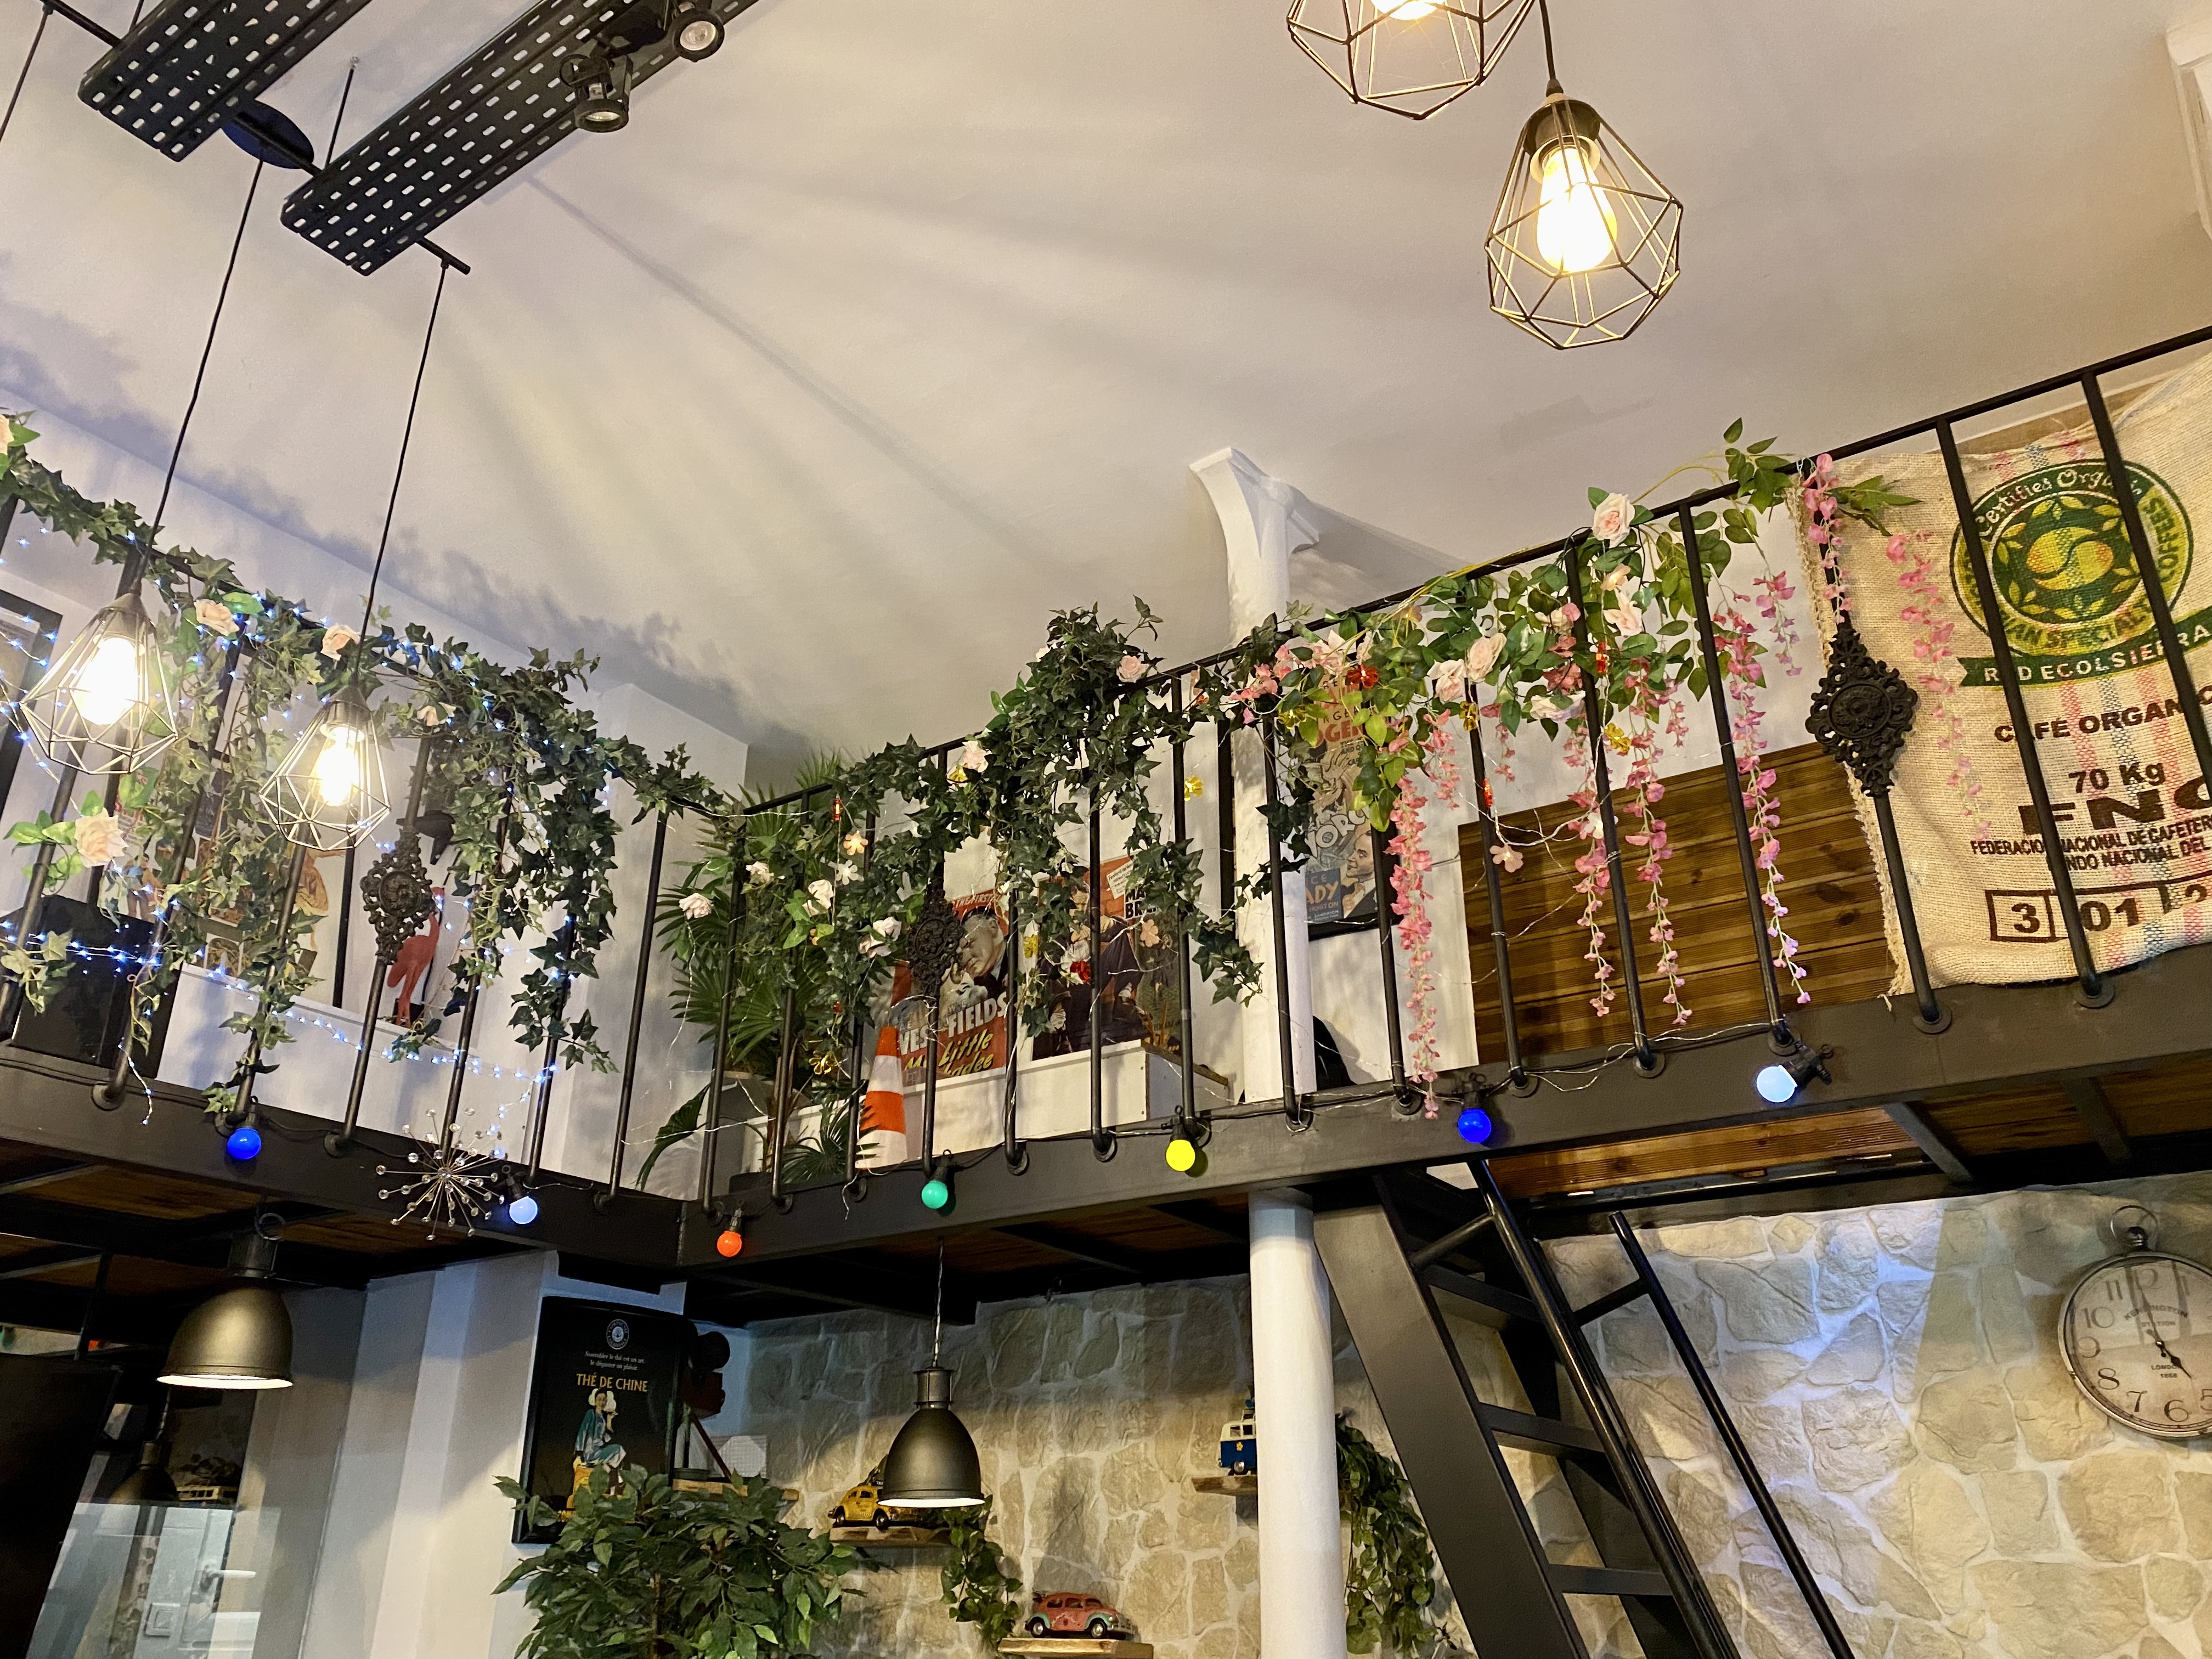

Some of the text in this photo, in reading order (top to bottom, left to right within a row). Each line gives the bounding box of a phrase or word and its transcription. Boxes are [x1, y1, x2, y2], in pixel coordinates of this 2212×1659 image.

[1984, 666, 2032, 682] RD
[1994, 718, 2071, 742] CFÉ
[2068, 762, 2166, 793] 70 Kg
[1970, 839, 2046, 855] FEDERACIO
[2149, 815, 2212, 844] CAFETER
[2011, 902, 2041, 934] 3
[2080, 898, 2140, 932] 01
[947, 991, 1007, 1038] FIELDS
[938, 1028, 994, 1067] Little
[2104, 1279, 2124, 1301] 11
[2081, 1306, 2115, 1329] 10
[2077, 1336, 2101, 1358] 9
[576, 1372, 648, 1392] THÉ DE CHINE
[2097, 1367, 2120, 1390] 8
[2126, 1390, 2148, 1413] 7
[2164, 1399, 2189, 1423] 6
[2200, 1389, 2212, 1412] 5
